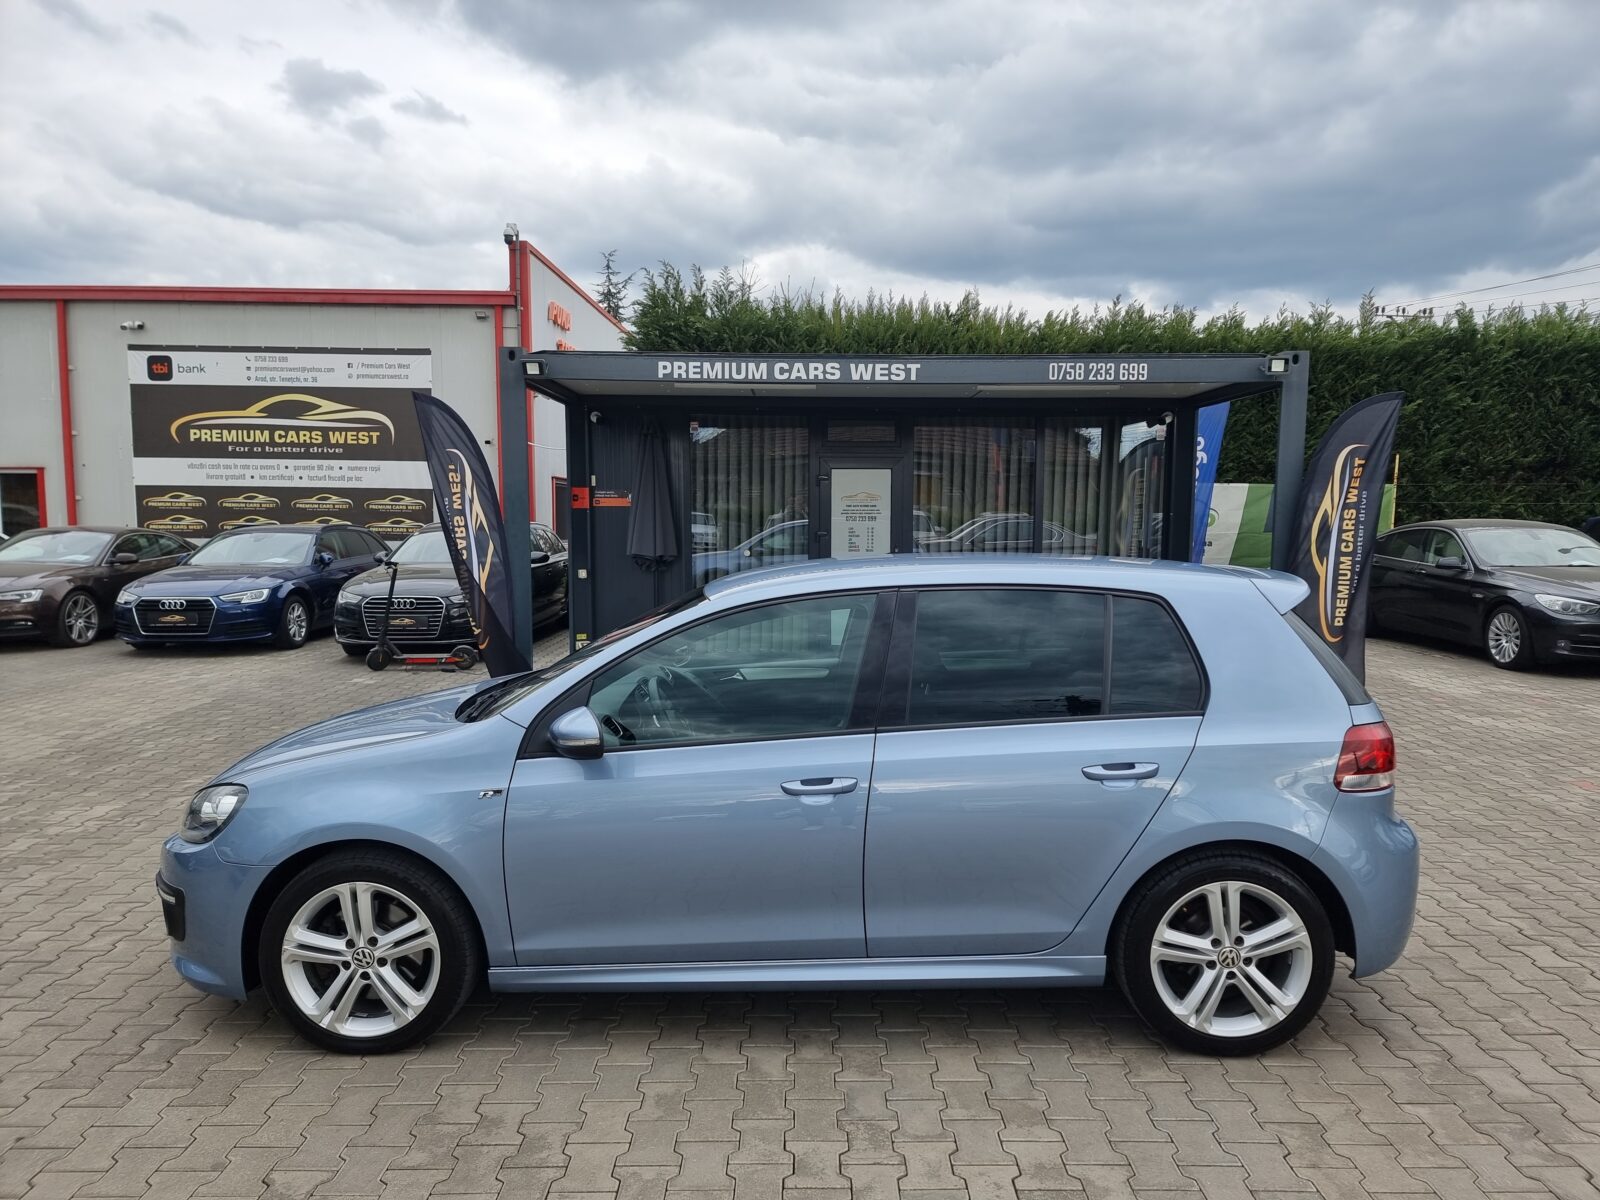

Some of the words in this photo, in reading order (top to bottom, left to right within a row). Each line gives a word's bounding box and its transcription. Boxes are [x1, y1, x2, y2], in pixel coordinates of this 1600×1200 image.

[152, 362, 168, 373] tbi
[177, 363, 206, 374] bank
[385, 362, 396, 370] Cars
[397, 362, 411, 370] West
[657, 361, 767, 380] PREMIUM
[773, 362, 841, 380] CARS
[850, 363, 921, 381] WEST
[1049, 362, 1084, 381] 0758
[1088, 363, 1114, 381] 233
[1119, 363, 1147, 381] 699
[189, 428, 270, 443] PREMIUM
[274, 430, 323, 444] CARS
[328, 431, 380, 445] WEST
[1346, 457, 1366, 503] WEST
[1358, 490, 1368, 521] drive
[1341, 508, 1357, 553] CARS
[1355, 524, 1364, 561] better
[1334, 557, 1352, 627] PREMIUM
